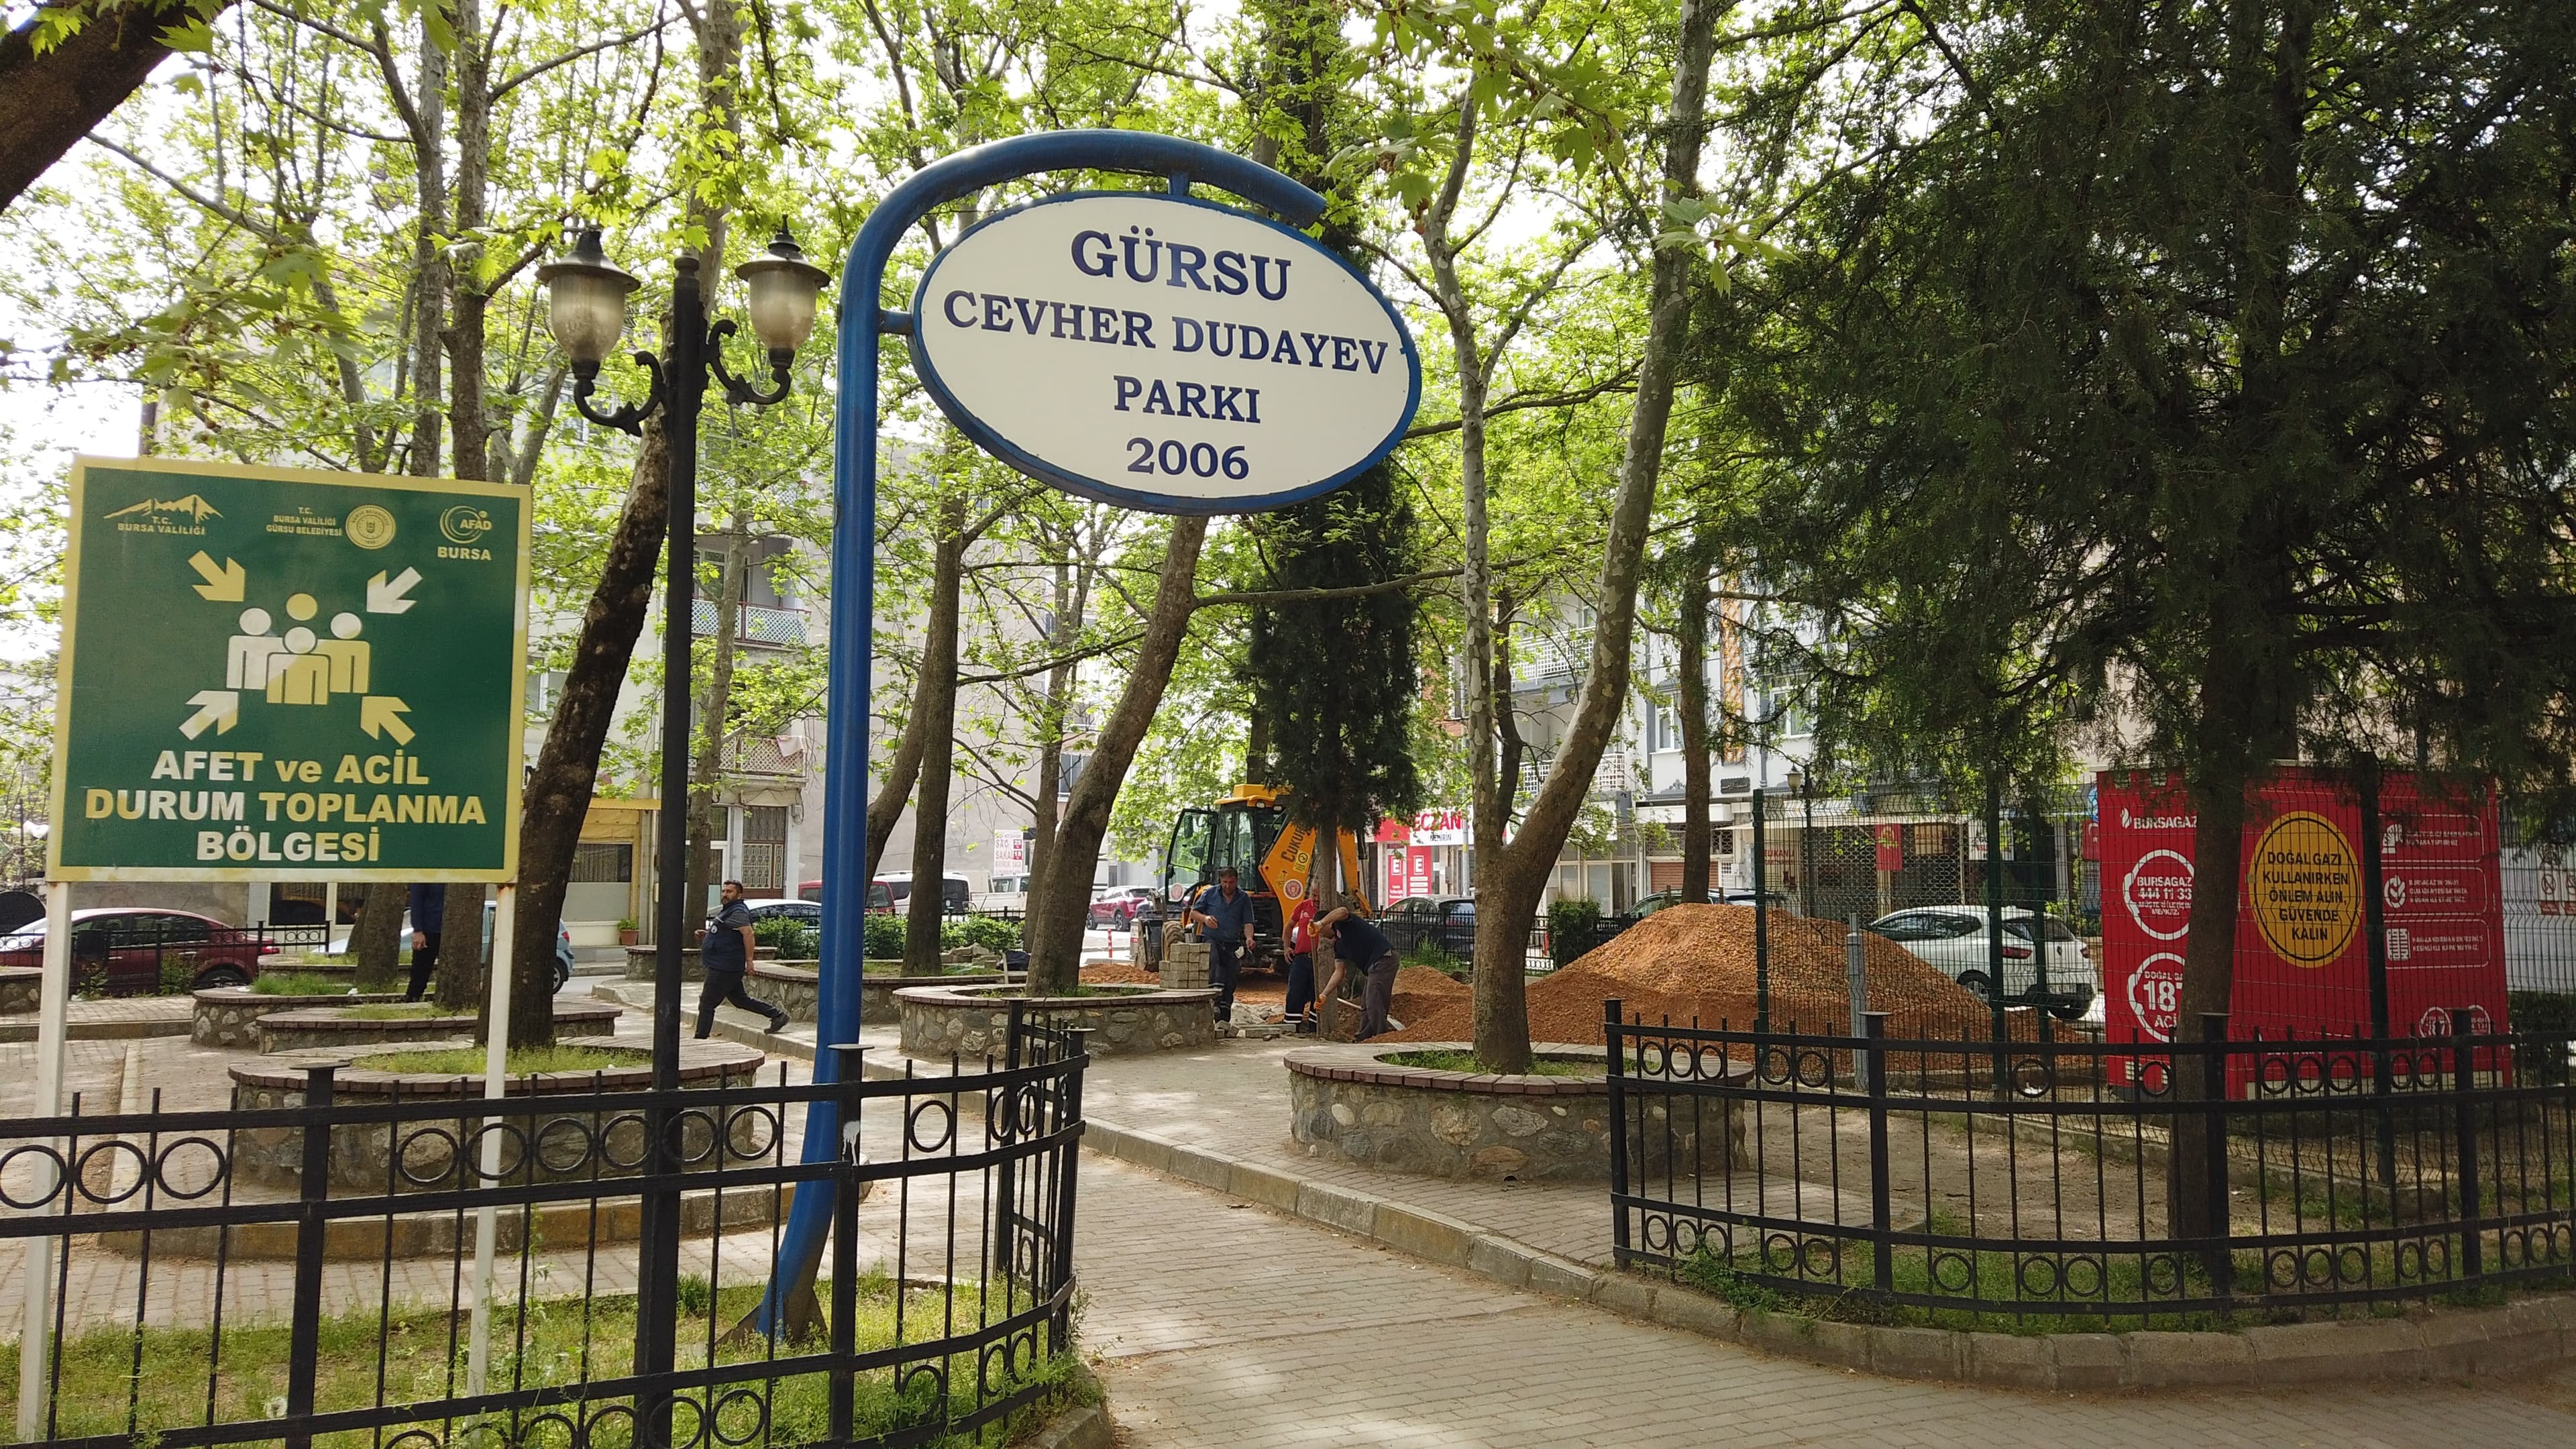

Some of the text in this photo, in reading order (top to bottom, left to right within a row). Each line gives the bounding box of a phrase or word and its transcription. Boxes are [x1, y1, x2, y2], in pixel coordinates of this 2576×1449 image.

[1071, 225, 1291, 301] GÜRSU
[943, 290, 1389, 374] CEVHER DUDAYEV
[1114, 374, 1261, 424] PARKI
[1126, 437, 1250, 480] 2006
[298, 506, 313, 515] T.C.
[152, 515, 172, 525] T.C.
[274, 515, 301, 523] BURSA
[460, 519, 492, 531] AFAD
[117, 523, 154, 533] BURSA
[266, 524, 342, 537] GÜRSU BELEDİYESİ
[437, 546, 492, 561] BURSA
[151, 749, 429, 785] AFET ve ACİL
[85, 789, 487, 824] DURUM TOPLANMA
[1413, 810, 1470, 831] ECZAN
[2133, 815, 2198, 830] BURSAGAZ
[197, 825, 380, 862] BÖLGESİ
[1415, 857, 1423, 873] E
[2267, 850, 2342, 866] DOĞAL GAZI
[2137, 876, 2193, 887] BURSAGAZ
[2263, 871, 2349, 885] KULLANIRKEN
[2139, 888, 2192, 900] 444 11 33
[2269, 887, 2313, 902] ÖNLEM
[2279, 906, 2339, 922] GÜVENDE
[2292, 928, 2328, 941] KALIN
[2144, 970, 2172, 979] DOĞAL
[2155, 1013, 2178, 1028] ACİ
